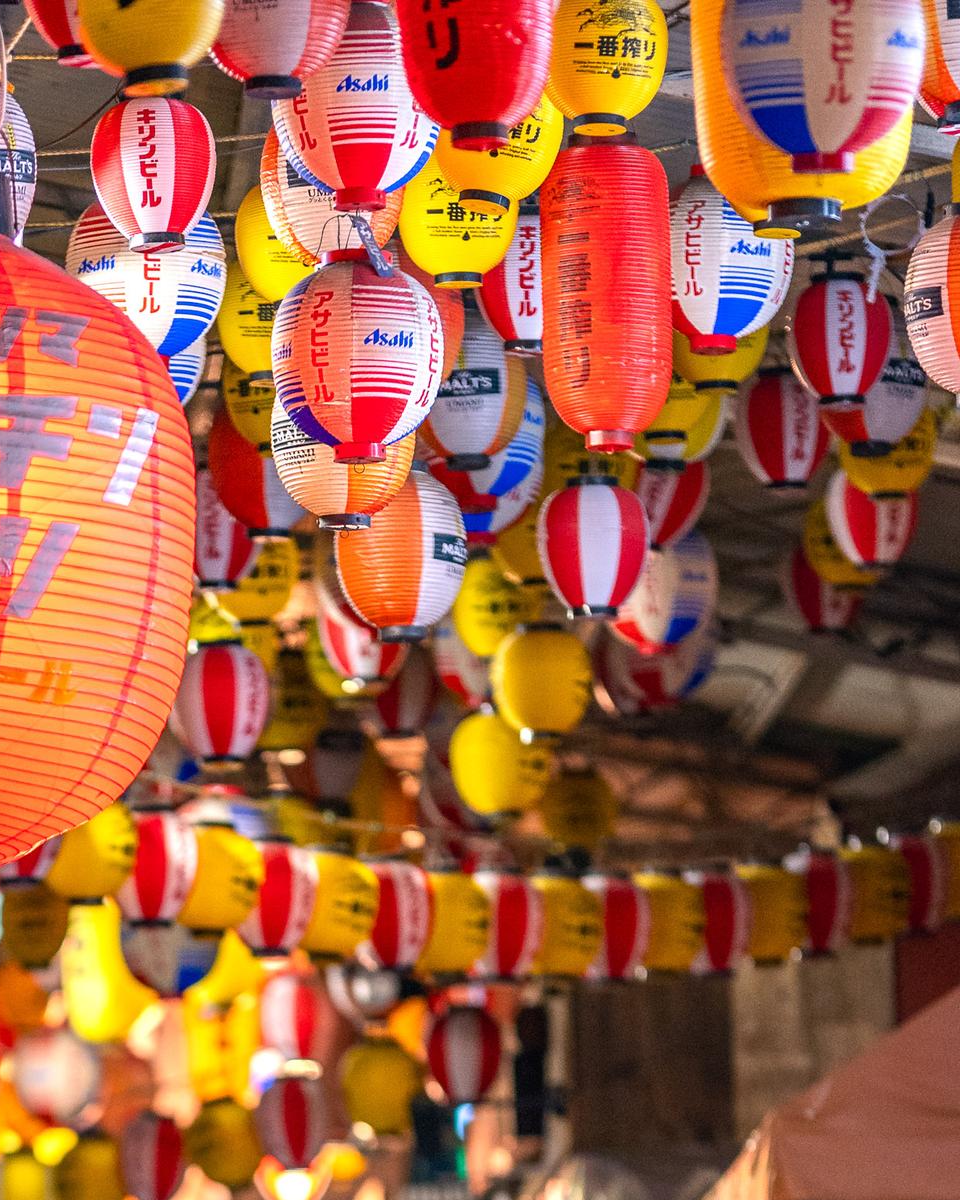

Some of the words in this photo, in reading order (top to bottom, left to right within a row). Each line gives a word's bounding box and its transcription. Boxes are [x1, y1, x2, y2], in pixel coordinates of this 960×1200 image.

[336, 74, 388, 92] Asahi
[574, 36, 656, 60] 一番搾り
[137, 109, 161, 208] キリンビール
[78, 255, 116, 274] Asahi
[191, 258, 222, 279] Asahi
[518, 226, 537, 317] キリンビール
[685, 200, 707, 296] アサヒビール
[730, 239, 771, 257] Asahi
[311, 291, 334, 403] アサヒビール
[364, 328, 414, 348] Asahi
[416, 295, 440, 407] アサヒビール
[558, 232, 592, 388] 一番搾り
[838, 289, 855, 374] キリンビール
